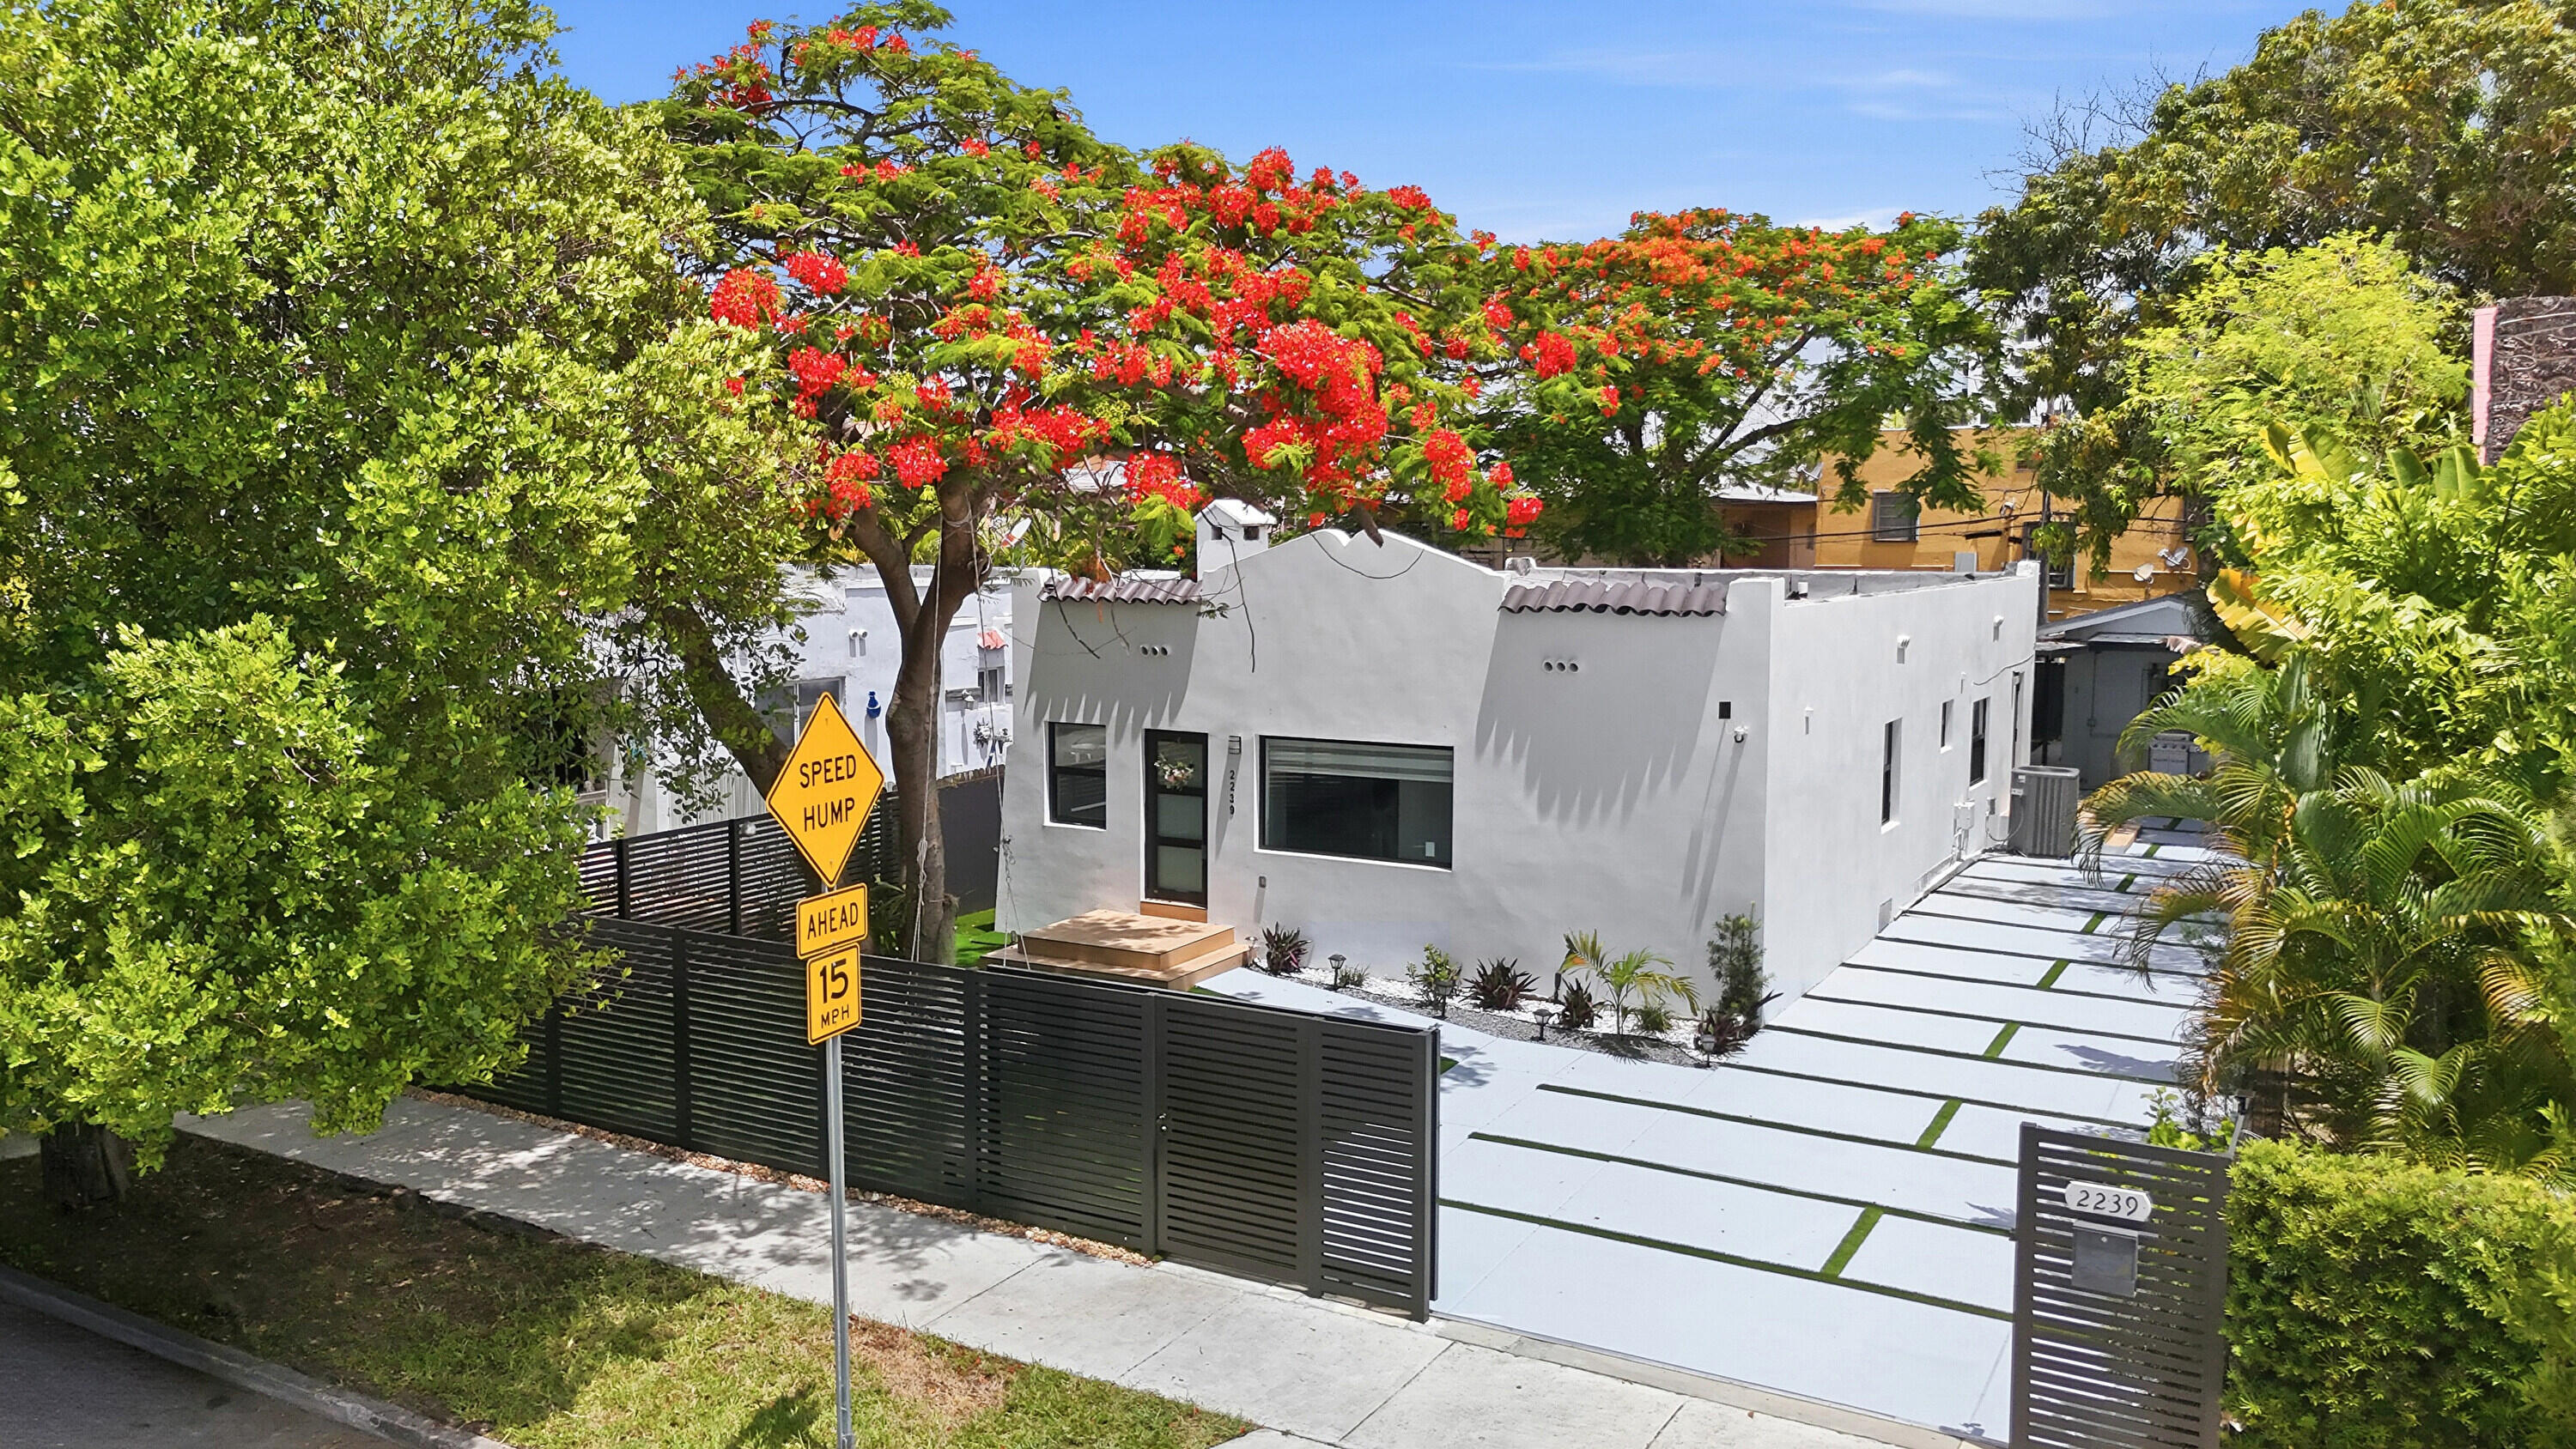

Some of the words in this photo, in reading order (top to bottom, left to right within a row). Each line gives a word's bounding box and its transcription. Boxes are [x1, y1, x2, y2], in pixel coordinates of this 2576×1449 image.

[799, 755, 857, 789] SPEED
[804, 797, 855, 832] HUMP
[807, 902, 859, 940] AHEAD
[819, 958, 849, 1004] 15
[821, 1008, 849, 1029] MPH
[2076, 1190, 2139, 1216] 2239
